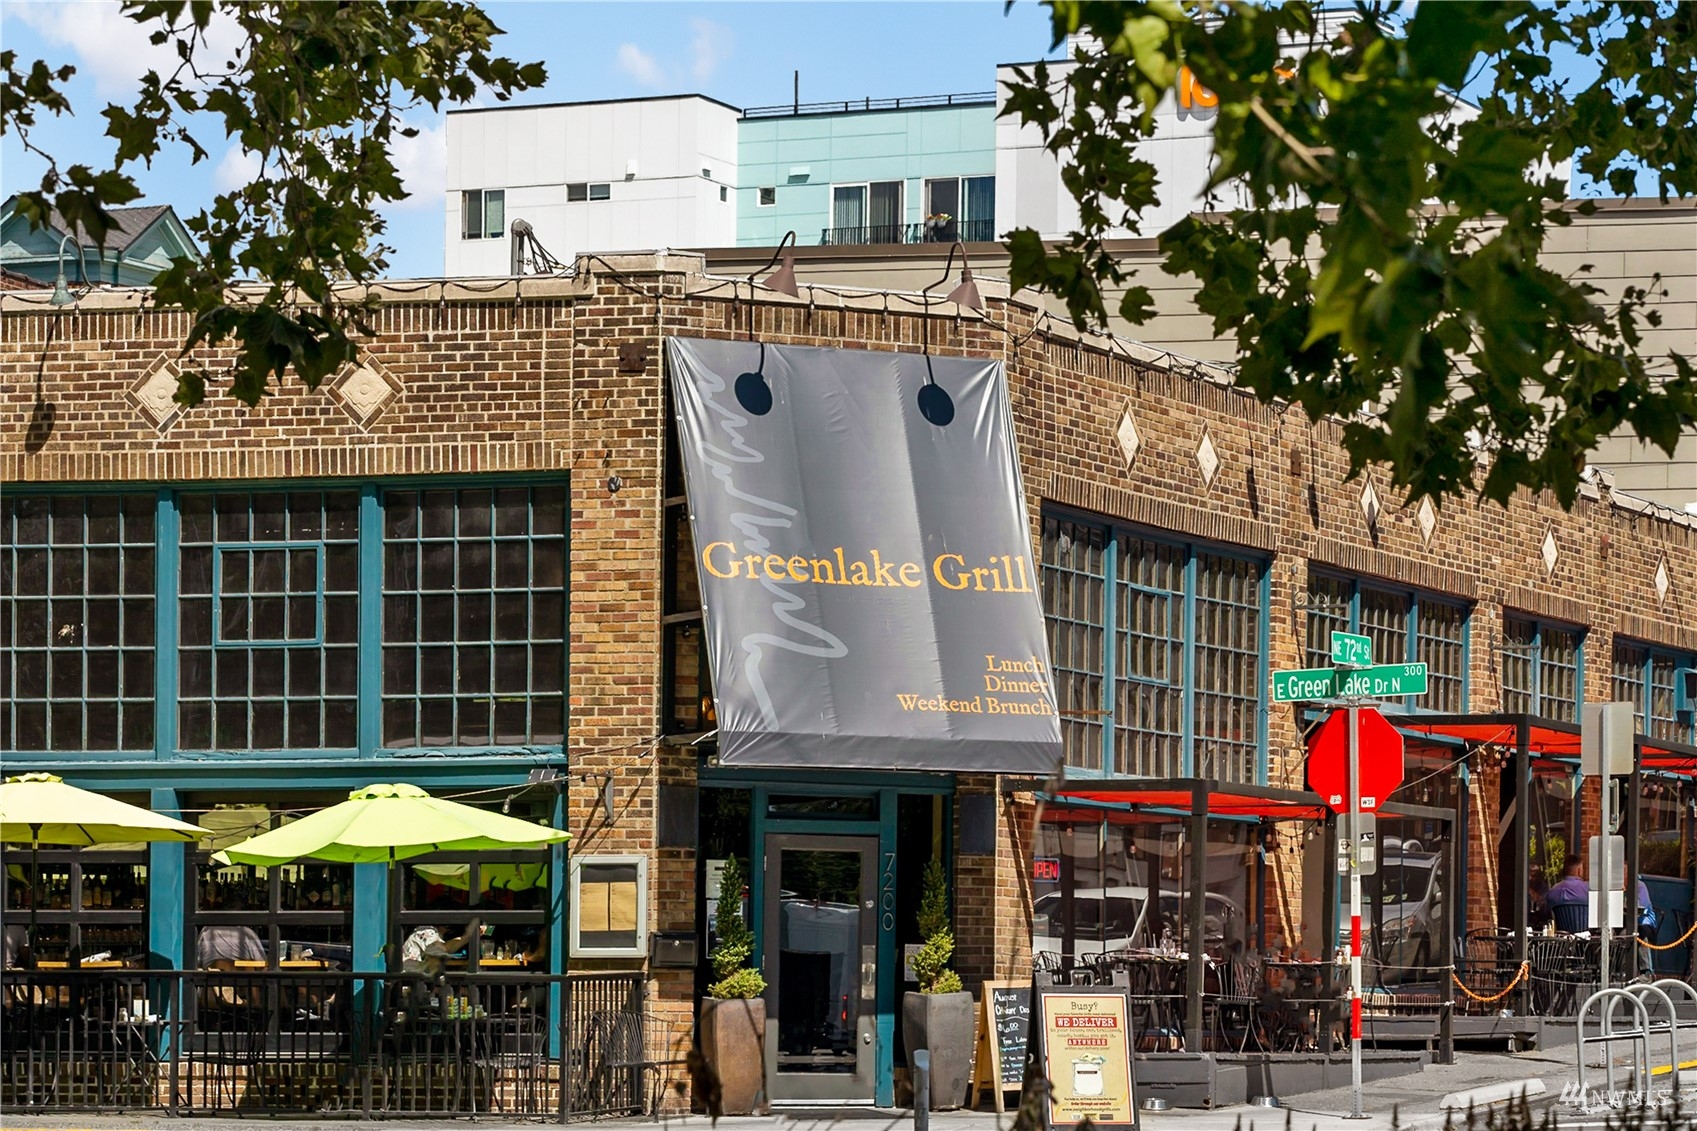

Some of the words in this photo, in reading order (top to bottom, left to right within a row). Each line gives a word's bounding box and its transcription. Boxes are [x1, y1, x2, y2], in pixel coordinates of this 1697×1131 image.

[702, 541, 921, 587] Greenlake
[933, 553, 1033, 592] Grill
[1333, 640, 1342, 656] NE
[986, 655, 1045, 673] Lunch
[1404, 666, 1422, 676] 300
[984, 675, 1048, 693] Dinner
[1277, 684, 1285, 698] E
[1288, 676, 1330, 698] Green
[1336, 674, 1370, 695] Lake
[1375, 680, 1388, 693] Dr
[1392, 678, 1400, 692] N
[897, 694, 983, 713] Weekend
[986, 697, 1053, 715] Brunch
[883, 853, 895, 931] 7200
[1071, 1002, 1098, 1012] Busy?
[1057, 1017, 1070, 1027] WE
[1073, 1017, 1114, 1027] DELIVER
